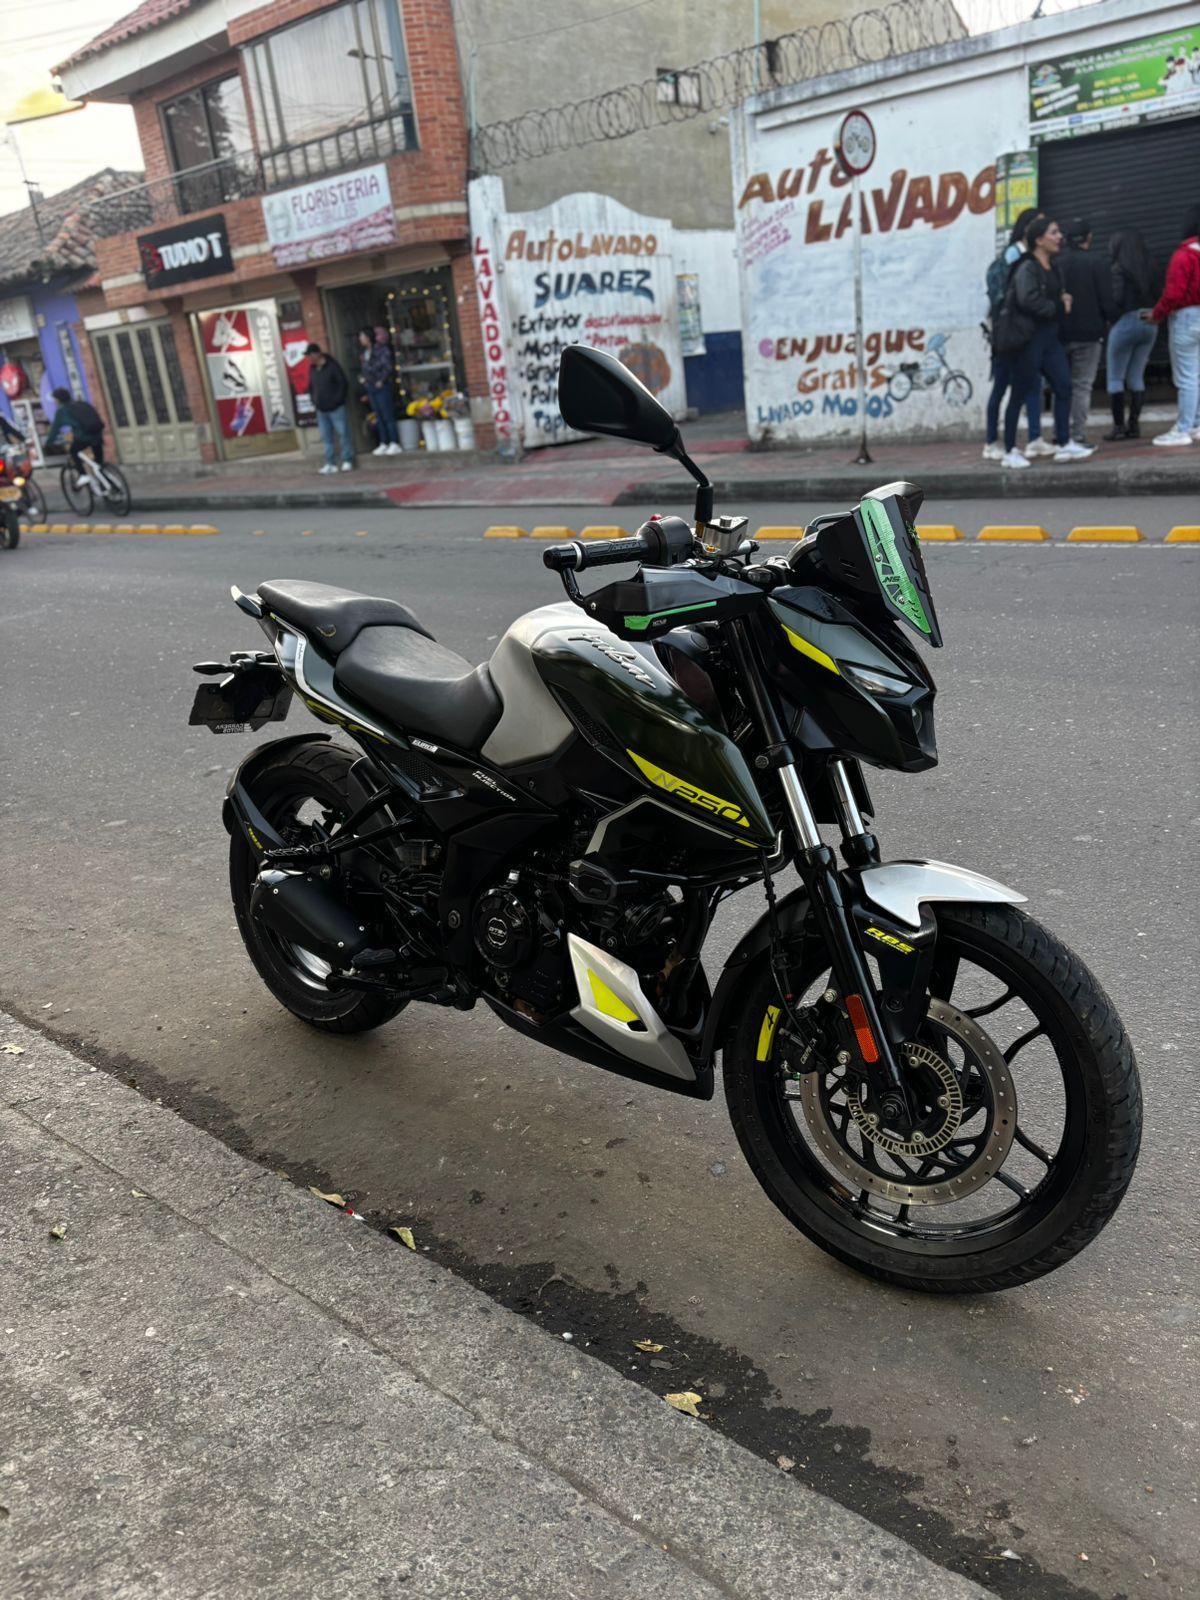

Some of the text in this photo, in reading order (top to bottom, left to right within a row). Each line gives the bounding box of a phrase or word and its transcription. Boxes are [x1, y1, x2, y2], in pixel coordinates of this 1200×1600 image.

[291, 174, 380, 214] FLORISTERIA
[804, 165, 997, 245] LAVADO
[533, 269, 655, 309] SUAREZ
[475, 236, 510, 439] LAVADO MOTOS
[518, 310, 581, 334] Exterior
[256, 314, 285, 417] SNEAKERS
[757, 393, 893, 424] LAVADO MOOS
[472, 773, 517, 802] INJECTION
[475, 770, 497, 786] FUEL
[653, 772, 743, 823] N250
[866, 927, 915, 953] ABS
